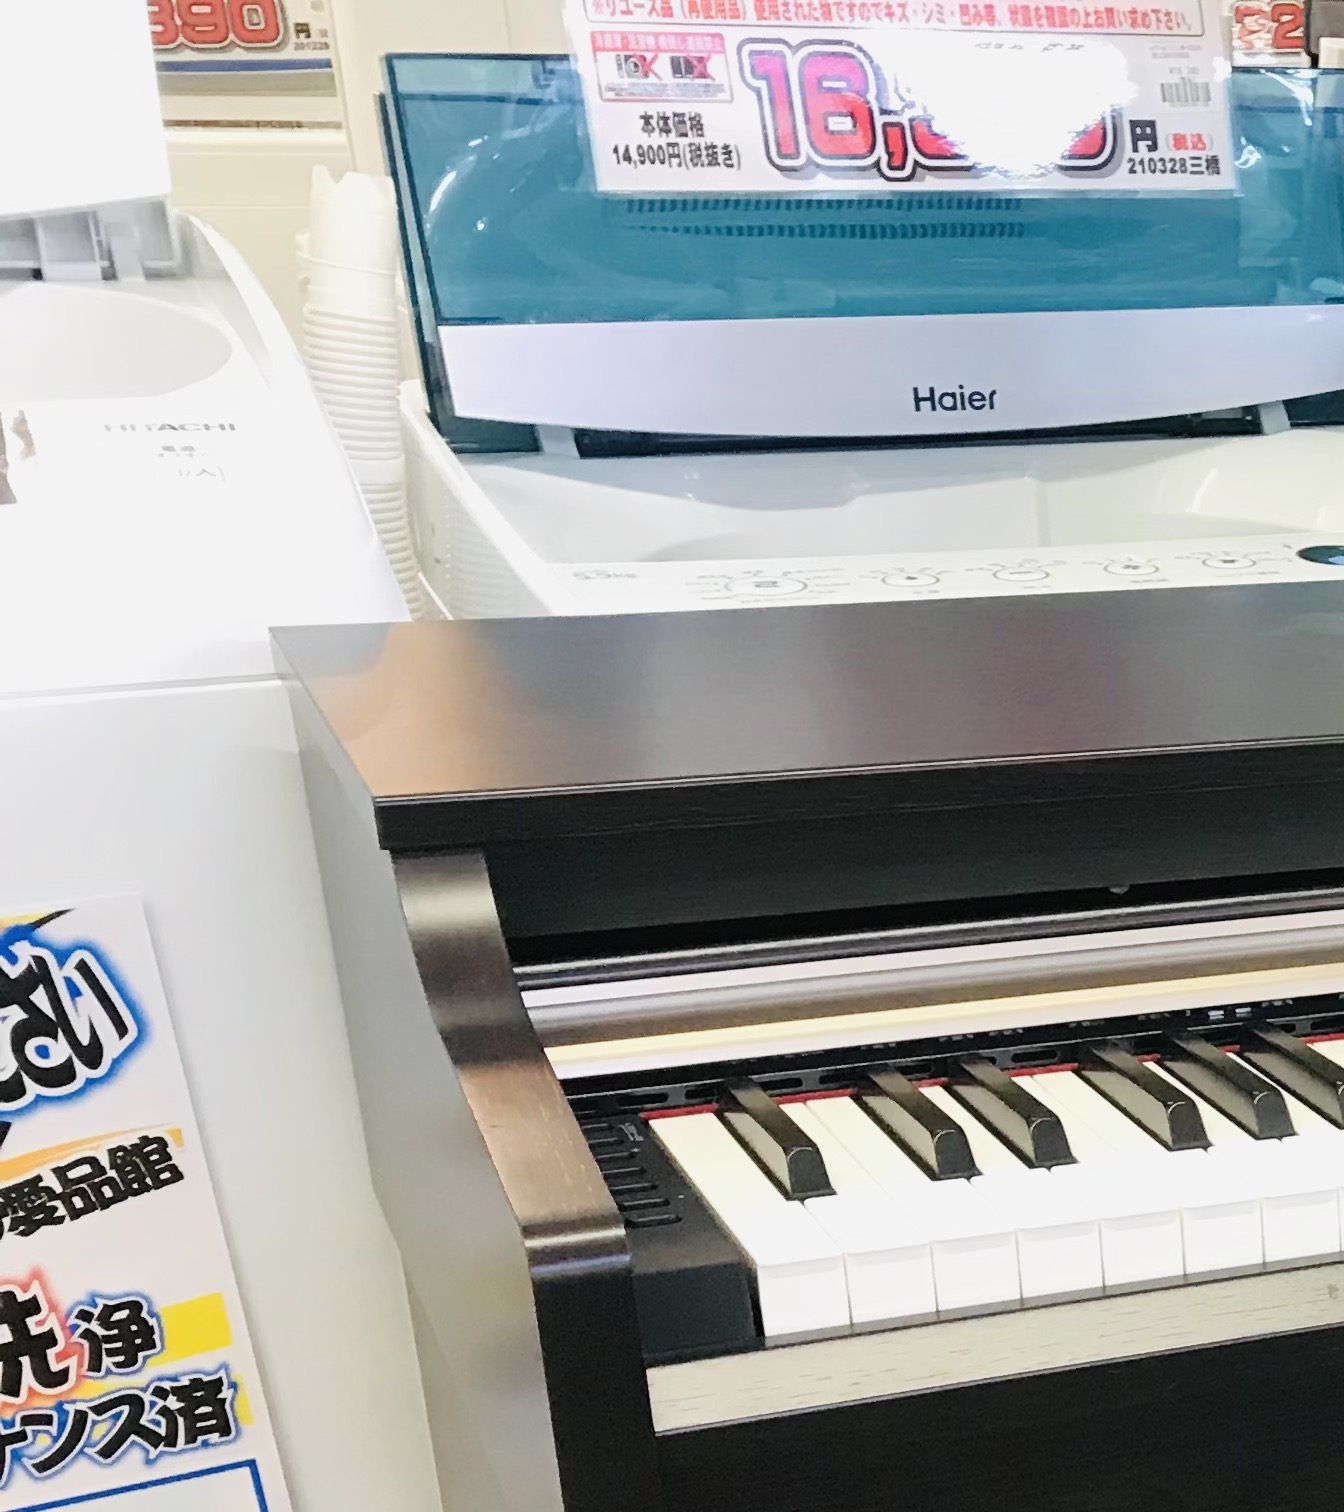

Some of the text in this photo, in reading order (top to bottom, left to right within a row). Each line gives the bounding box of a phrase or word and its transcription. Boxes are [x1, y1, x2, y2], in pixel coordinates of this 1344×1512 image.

[639, 111, 705, 138] 本体価格
[1129, 119, 1158, 153] 円
[912, 384, 997, 412] Haier
[0, 1135, 185, 1240] 愛品館
